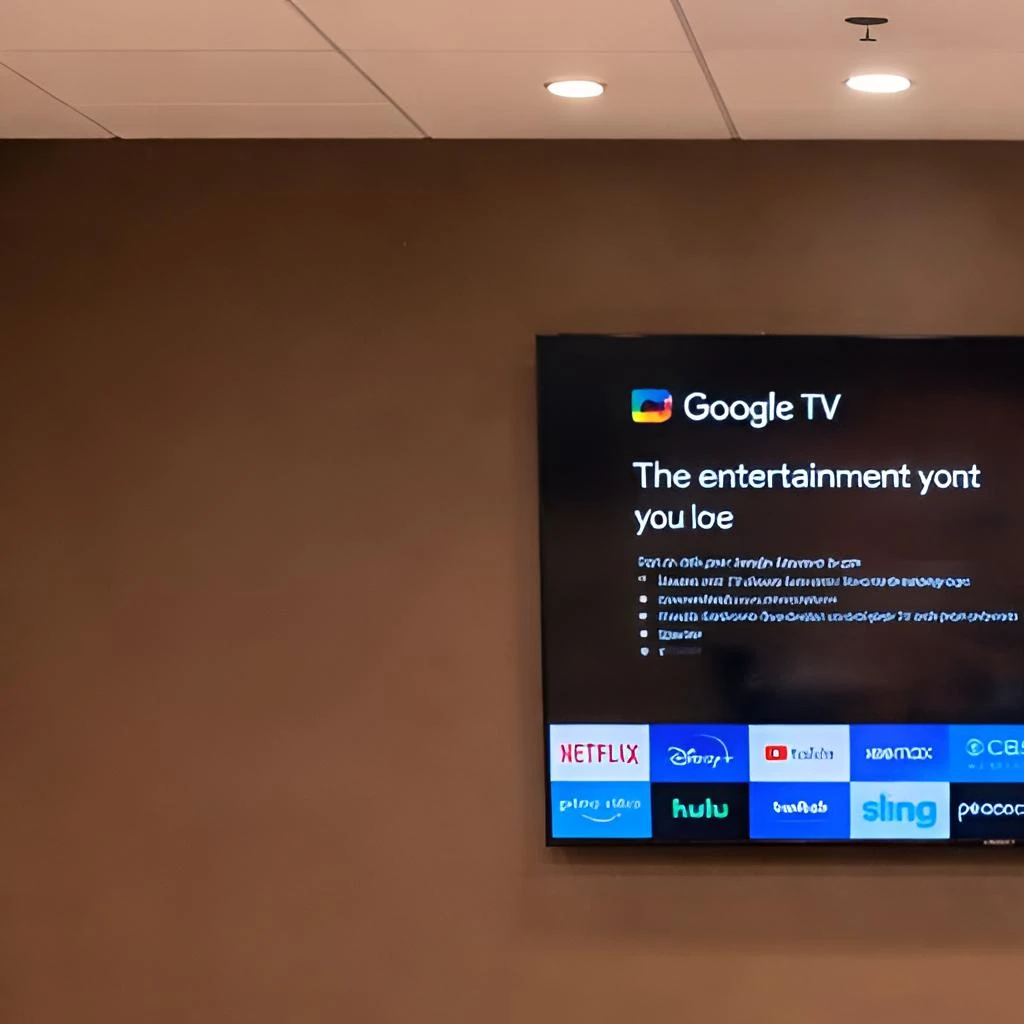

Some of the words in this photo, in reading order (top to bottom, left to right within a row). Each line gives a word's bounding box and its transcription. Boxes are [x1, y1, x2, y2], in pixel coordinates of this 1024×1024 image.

[683, 391, 794, 428] Google
[801, 393, 841, 420] TV
[632, 461, 691, 489] The
[699, 463, 911, 489] entertainment
[918, 464, 981, 495] yont
[634, 508, 685, 535] you
[560, 744, 639, 765] NETFLIX
[672, 798, 729, 819] hulu
[862, 793, 937, 828] sling
